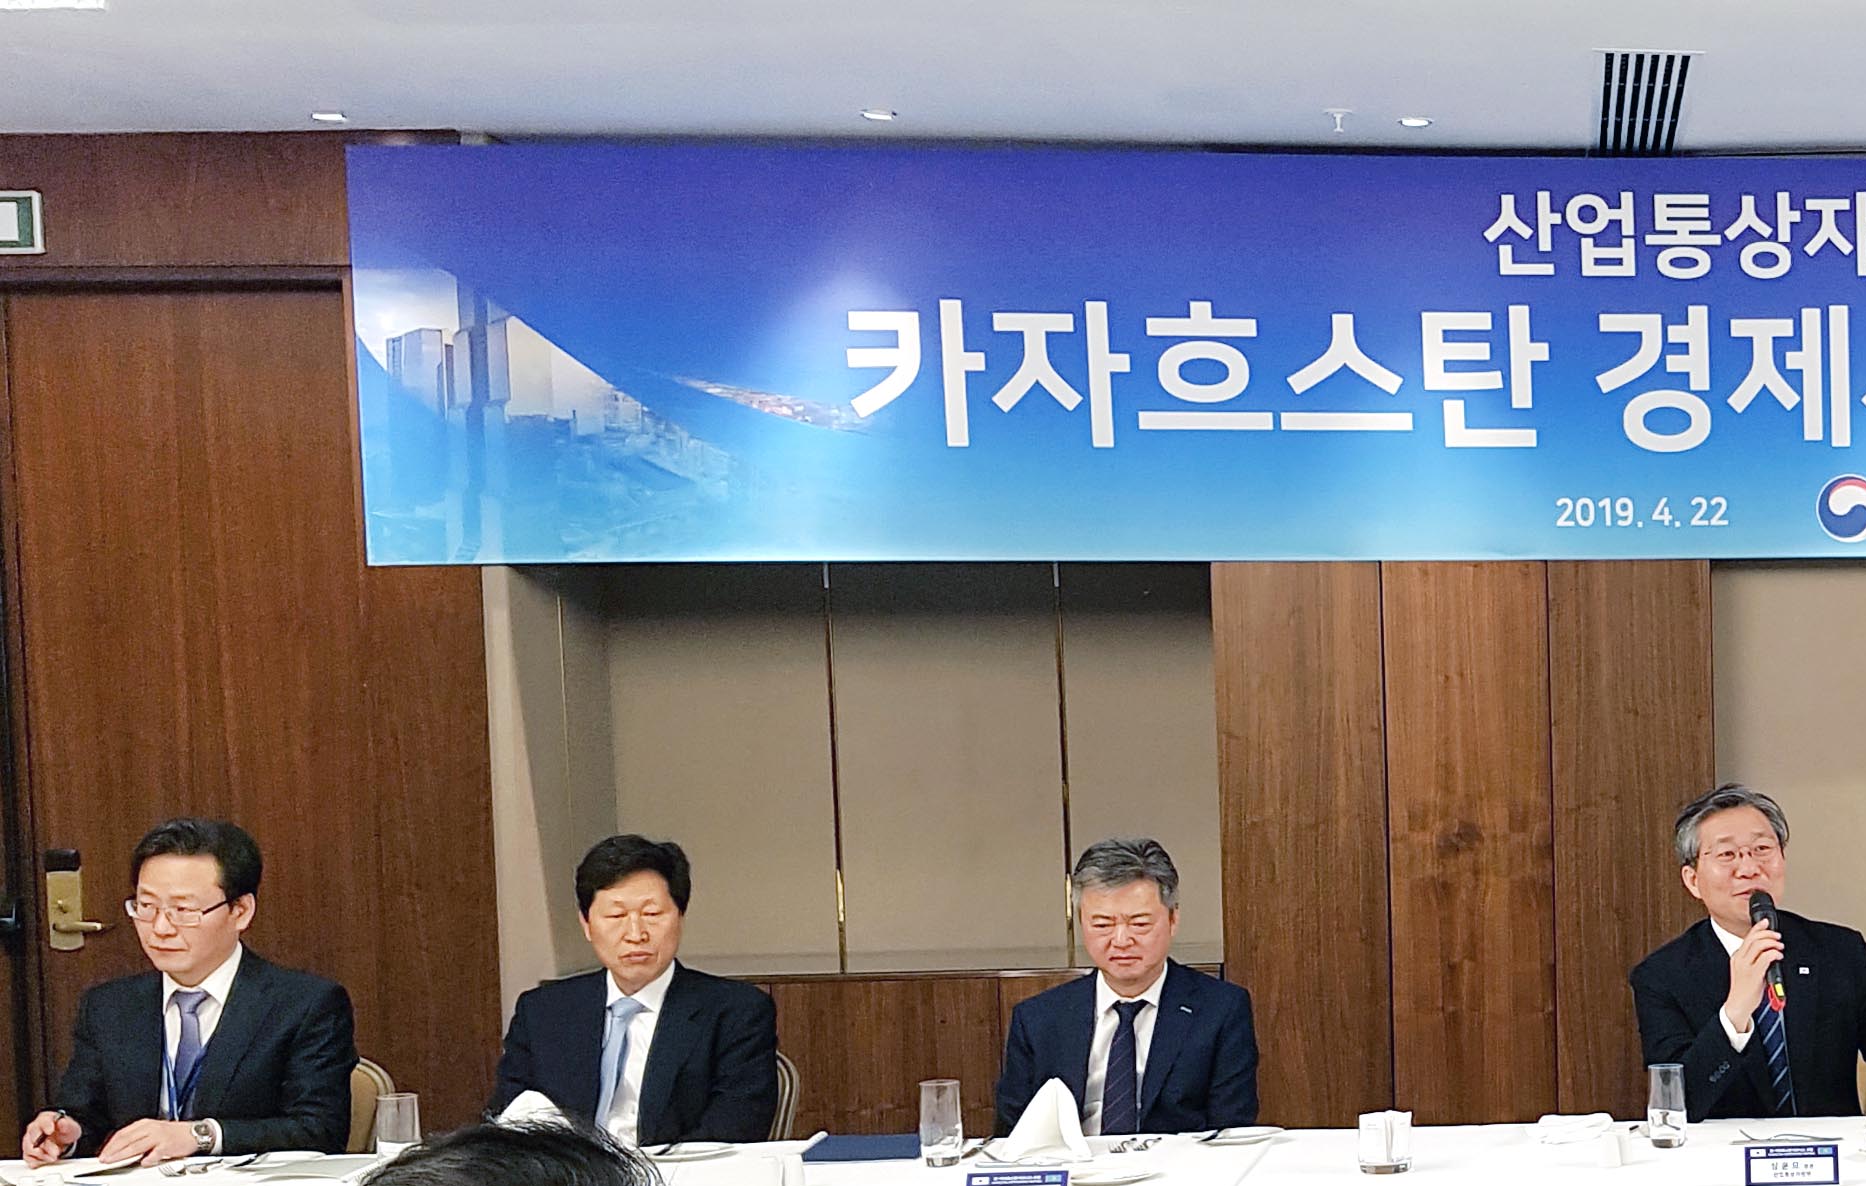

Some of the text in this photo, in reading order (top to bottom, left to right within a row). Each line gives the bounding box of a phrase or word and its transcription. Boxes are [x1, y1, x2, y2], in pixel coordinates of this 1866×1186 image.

[845, 299, 1549, 447] 카자흐스탄
[1556, 497, 1729, 527] 2019. 4. 22
